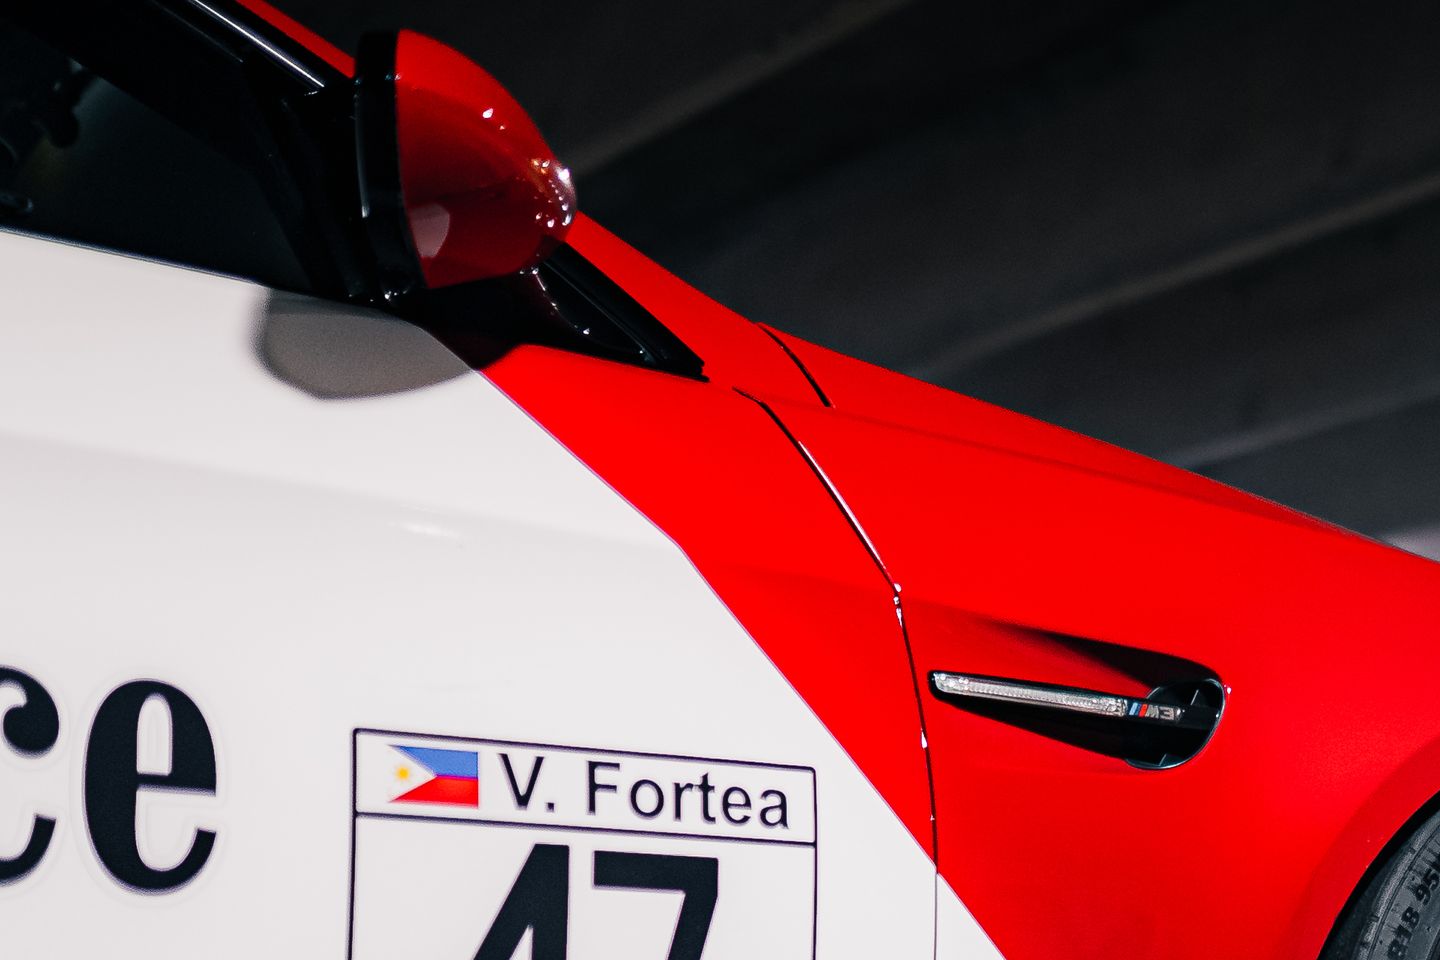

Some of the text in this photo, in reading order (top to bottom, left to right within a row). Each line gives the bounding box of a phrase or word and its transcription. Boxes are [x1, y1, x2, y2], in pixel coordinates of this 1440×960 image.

[1143, 703, 1175, 720] M3
[498, 753, 790, 830] V. Fortea
